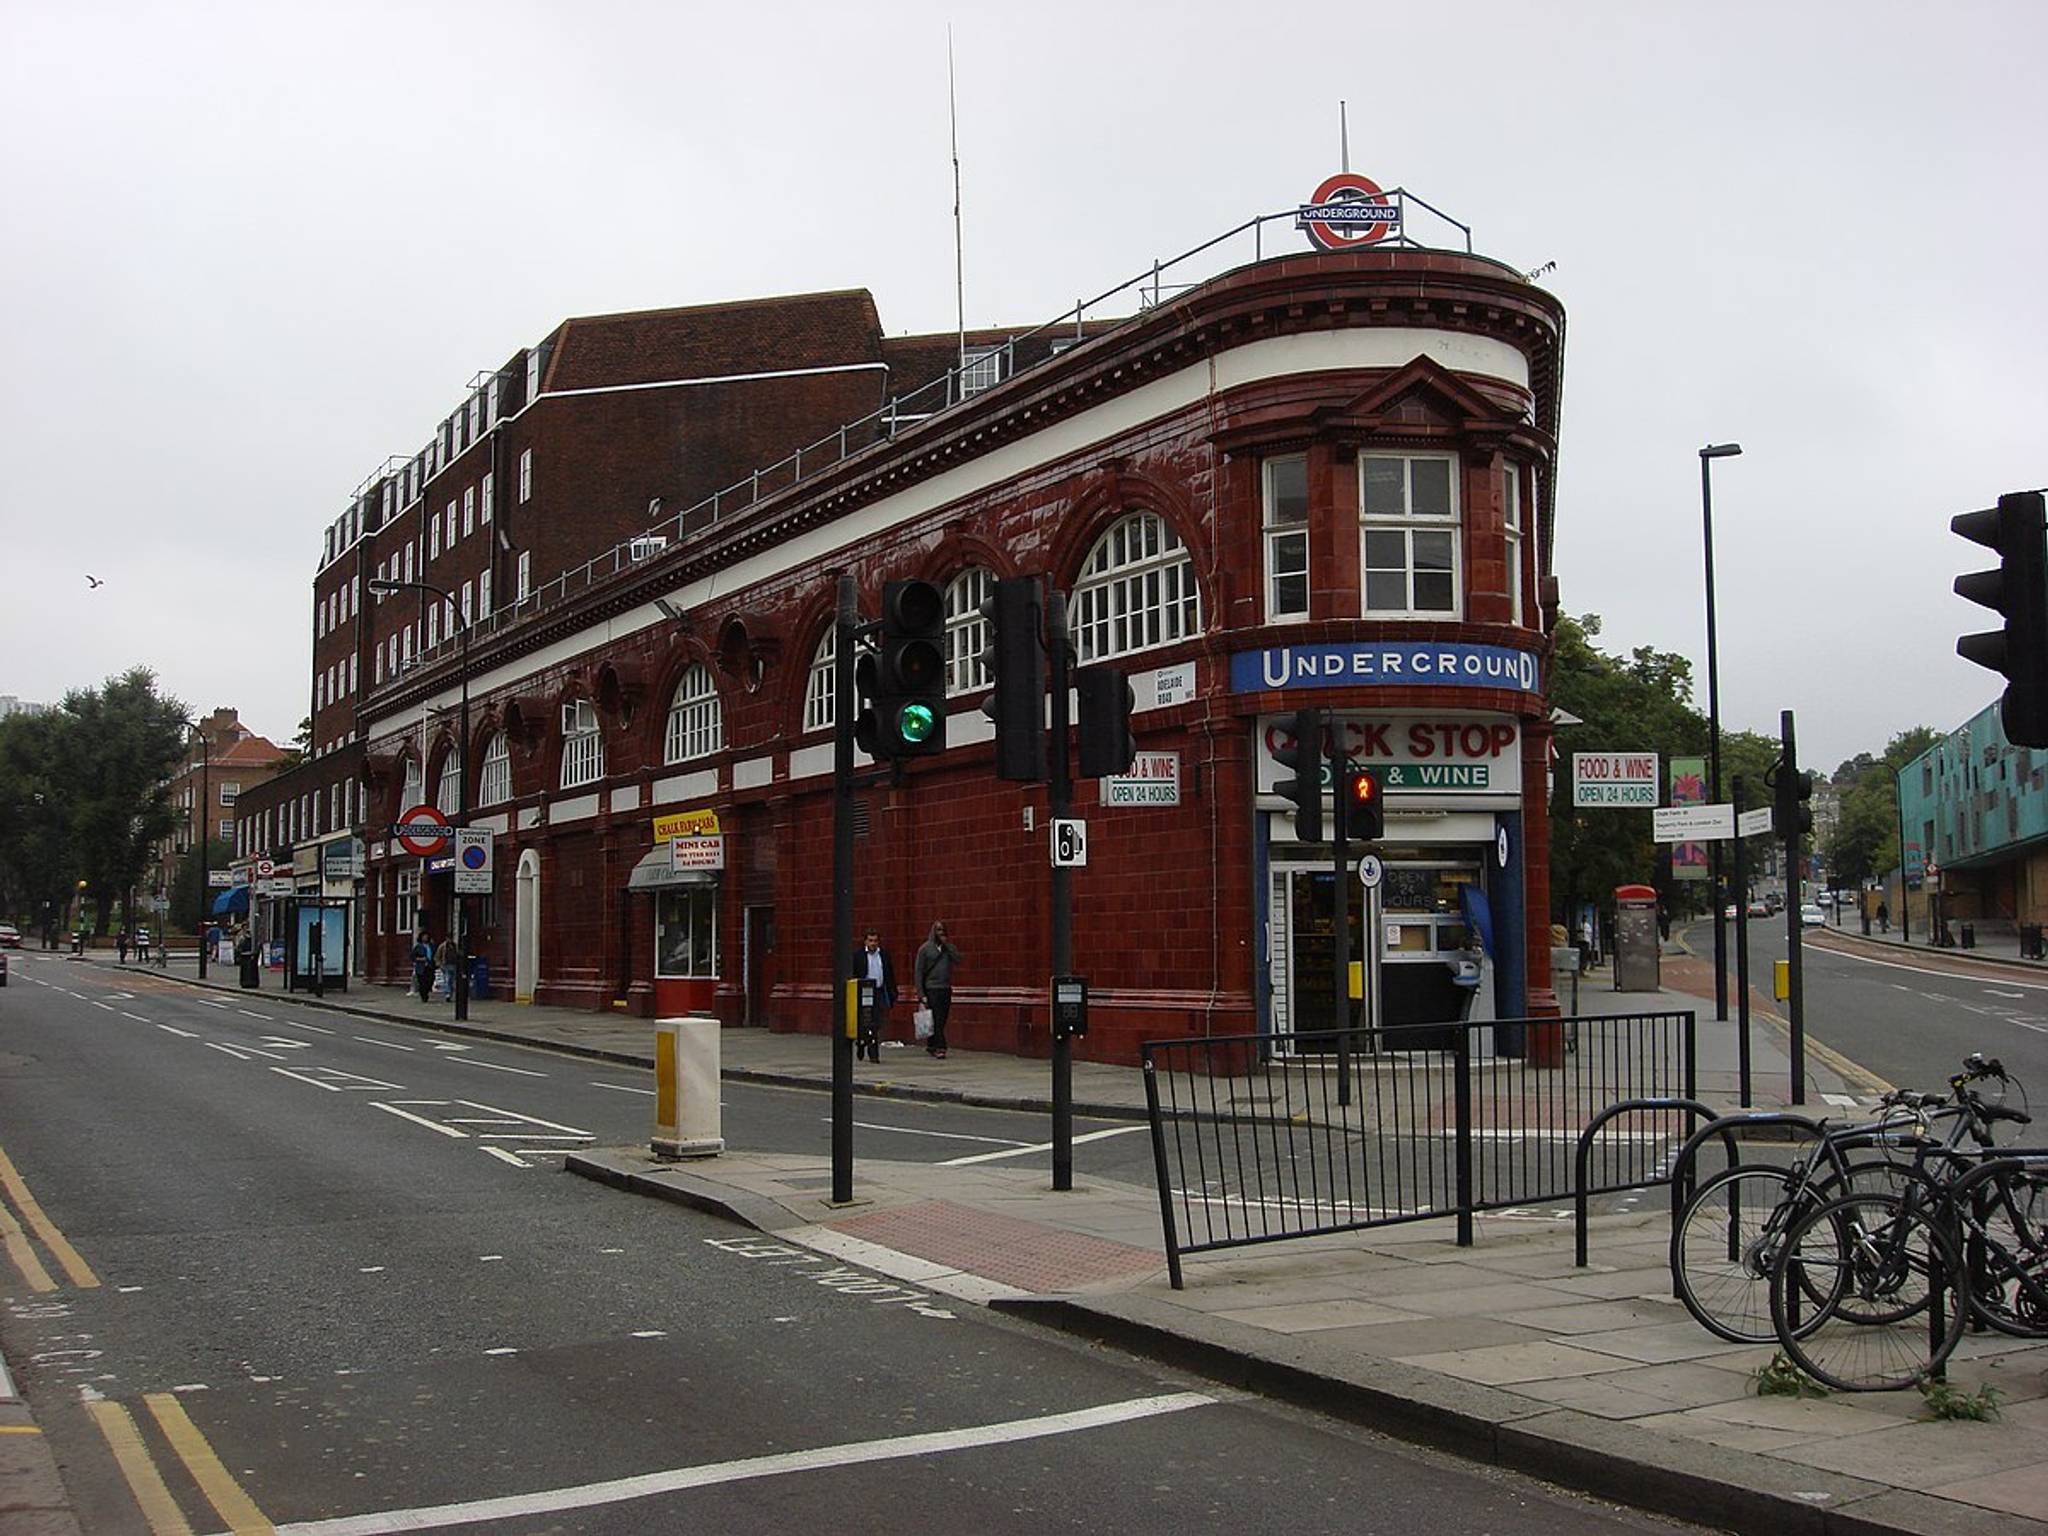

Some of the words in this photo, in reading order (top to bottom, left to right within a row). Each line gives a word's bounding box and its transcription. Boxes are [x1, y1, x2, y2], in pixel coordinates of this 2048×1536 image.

[1303, 208, 1396, 219] UNDERGROUND
[1262, 648, 1533, 689] UNDERGROUND
[1157, 676, 1182, 691] ADELAIDE
[1407, 723, 1516, 758] STOP
[1141, 758, 1148, 778] &
[1150, 758, 1175, 778] WINE
[1387, 766, 1404, 785] &
[1419, 766, 1488, 786] WINE
[1578, 758, 1609, 779] FOOD
[1613, 758, 1621, 779] &
[1625, 758, 1653, 779] WINE
[1112, 787, 1134, 803] OPEN
[1136, 787, 1146, 802] 24
[1148, 786, 1176, 802] HOURS
[1578, 786, 1604, 802] OPEN
[1607, 786, 1618, 802] 24
[1621, 786, 1655, 802] HOURS
[462, 836, 486, 844] ZONE
[676, 841, 699, 850] MINI
[700, 840, 720, 849] CAB
[1387, 871, 1425, 882] OPEN
